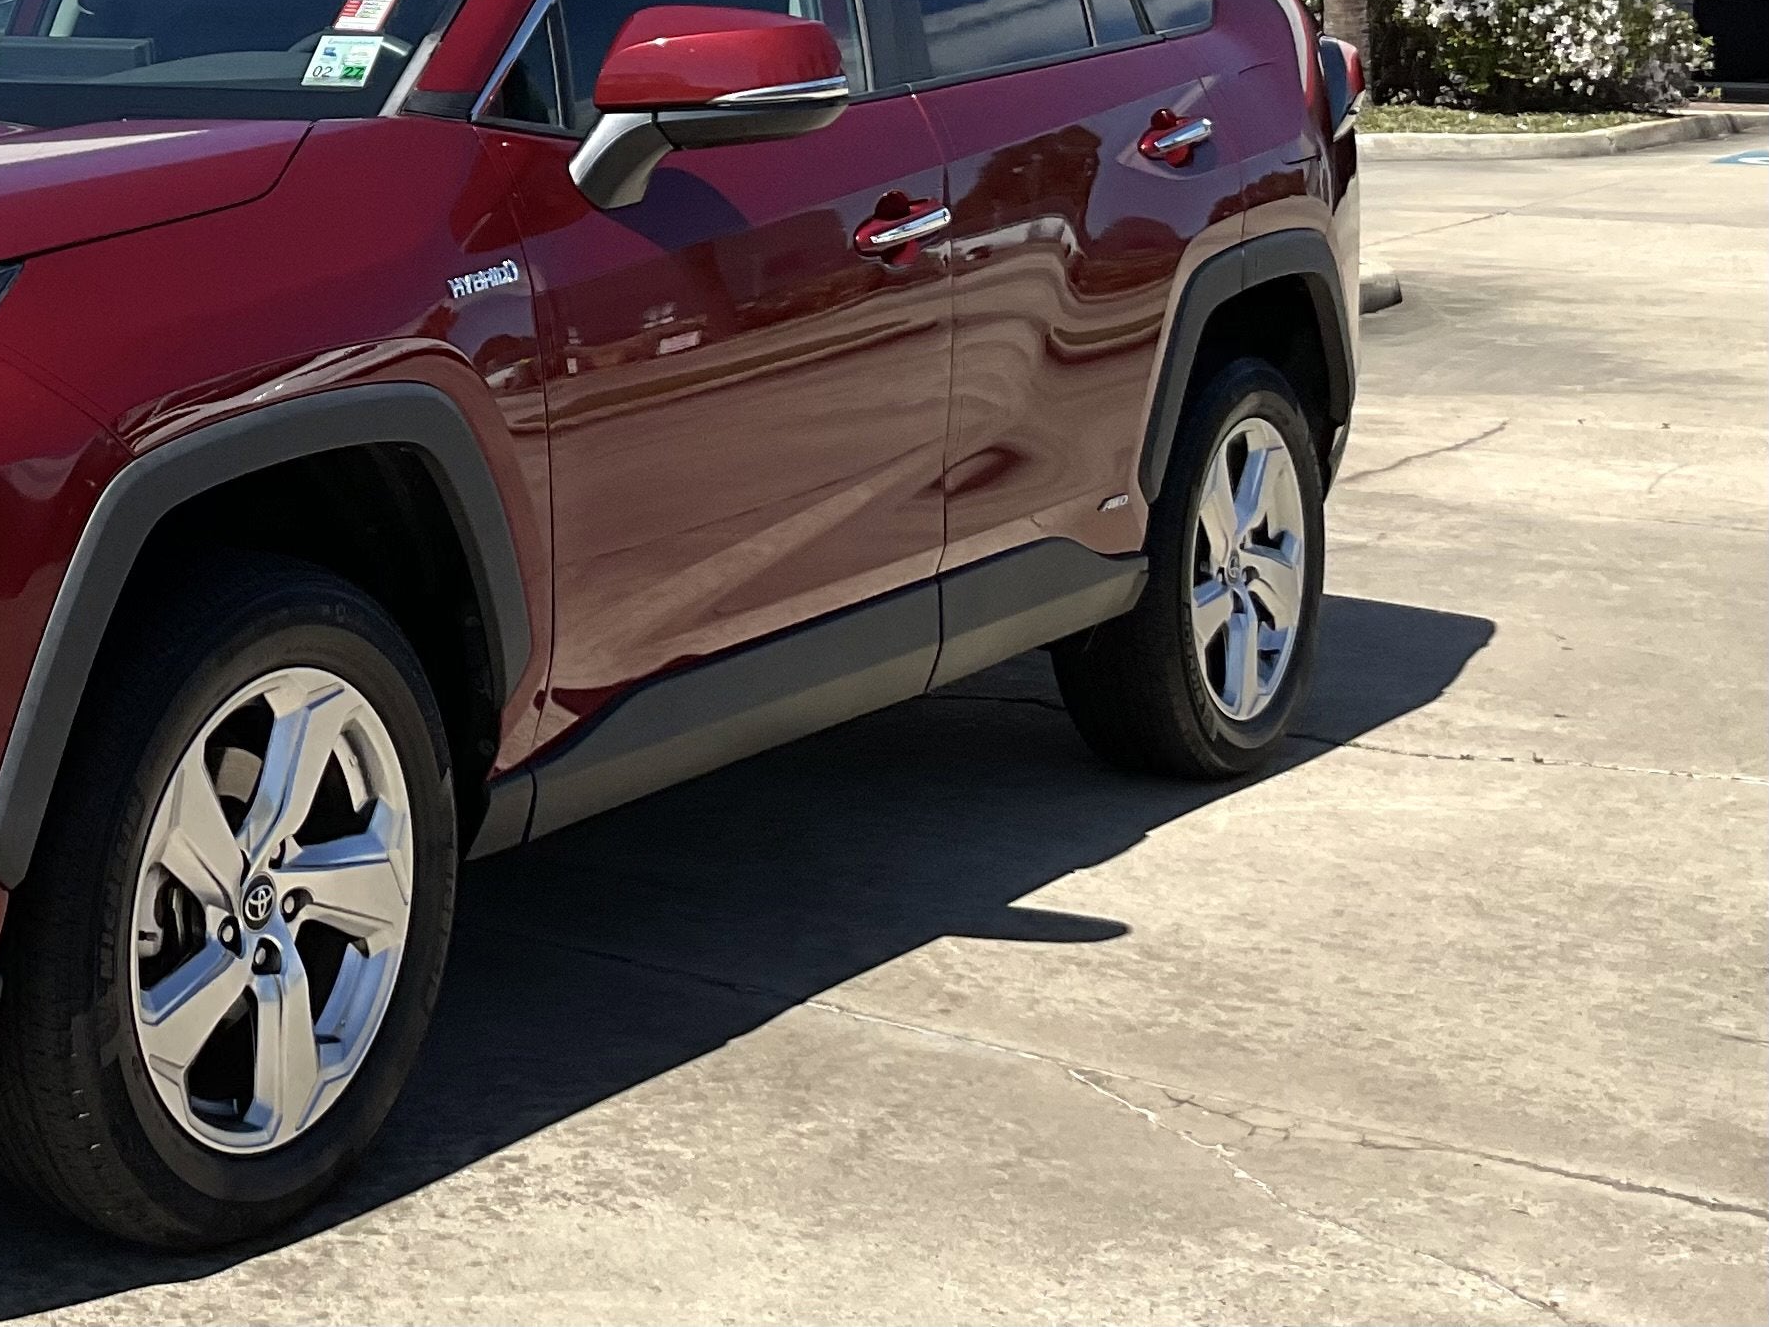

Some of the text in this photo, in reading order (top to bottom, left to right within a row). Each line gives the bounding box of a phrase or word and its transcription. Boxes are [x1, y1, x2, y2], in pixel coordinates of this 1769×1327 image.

[312, 66, 366, 79] 02 27
[446, 258, 520, 300] HYBRID
